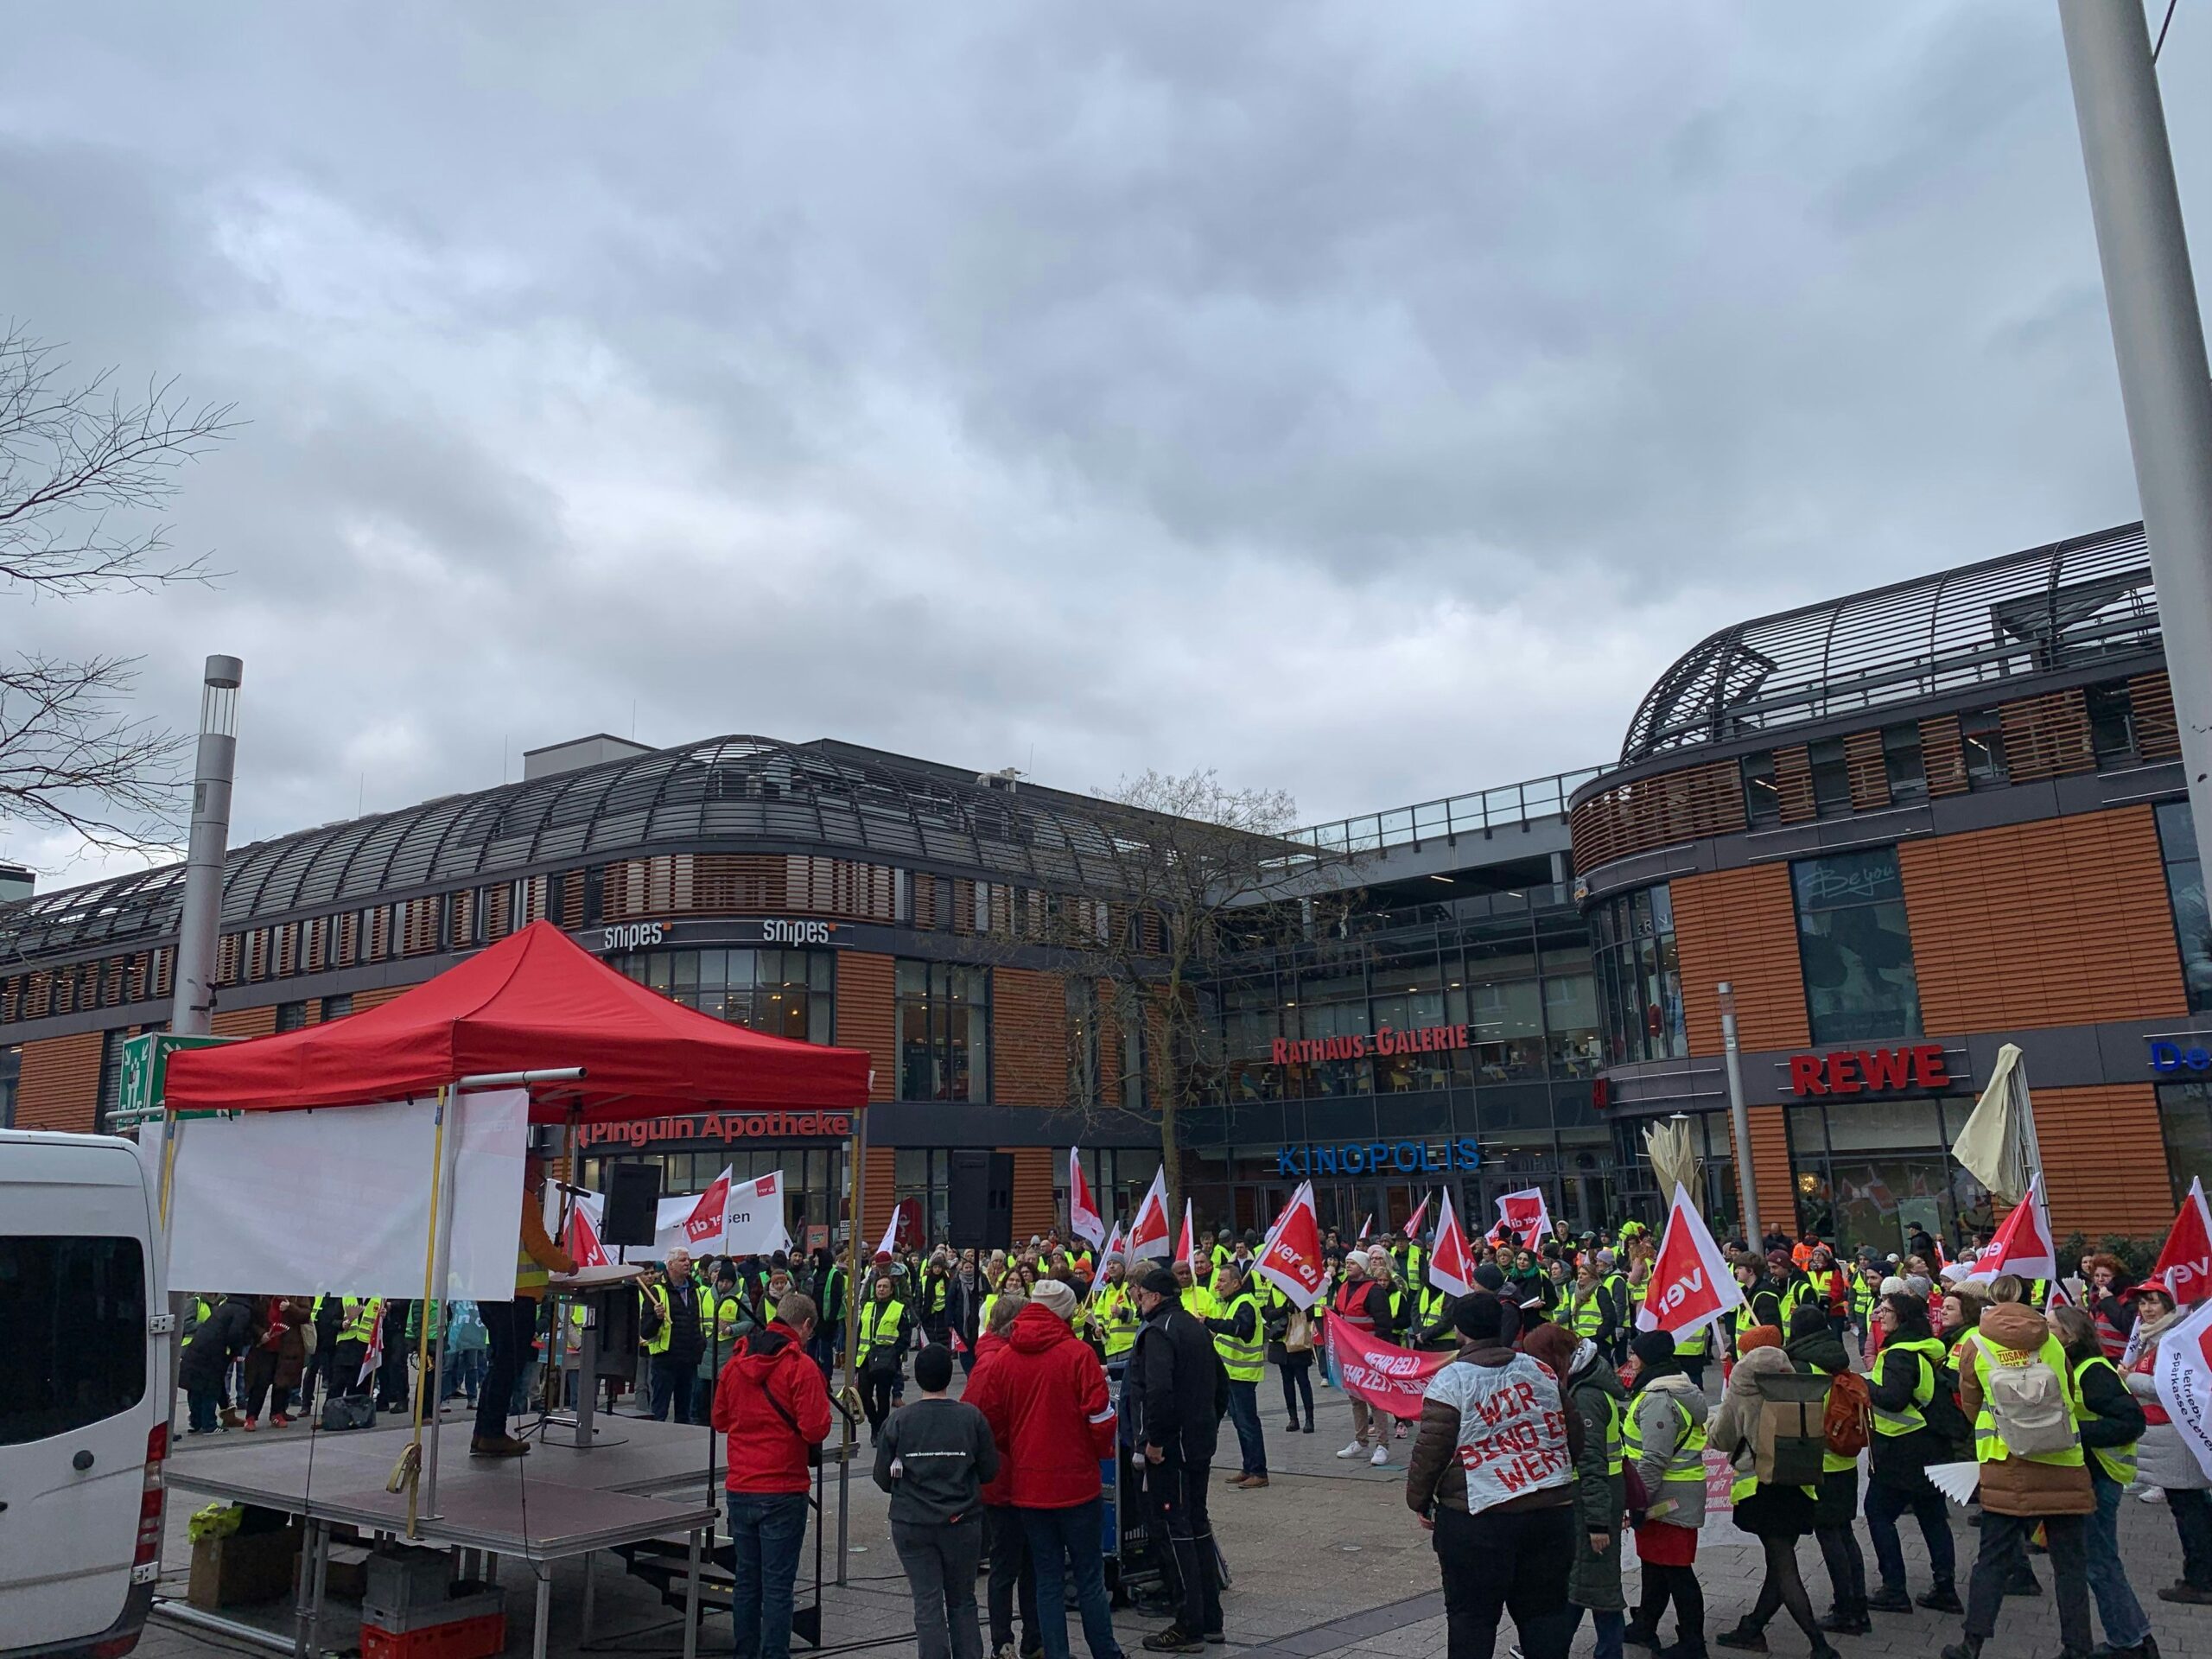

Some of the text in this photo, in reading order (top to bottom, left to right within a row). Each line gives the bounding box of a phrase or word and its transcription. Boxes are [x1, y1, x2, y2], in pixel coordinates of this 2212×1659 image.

[604, 922, 663, 951] snipes
[763, 919, 830, 947] snipes
[1790, 1045, 1949, 1096] REWE
[590, 1116, 695, 1148] Pinguin
[700, 1109, 849, 1143] Apotheke
[1277, 1138, 1481, 1176] KINOPOLIS
[1474, 1382, 1540, 1427] WIR
[2170, 1352, 2189, 1417] Sparkasse
[1456, 1421, 1540, 1471] SIND
[1493, 1444, 1569, 1493] WERT
